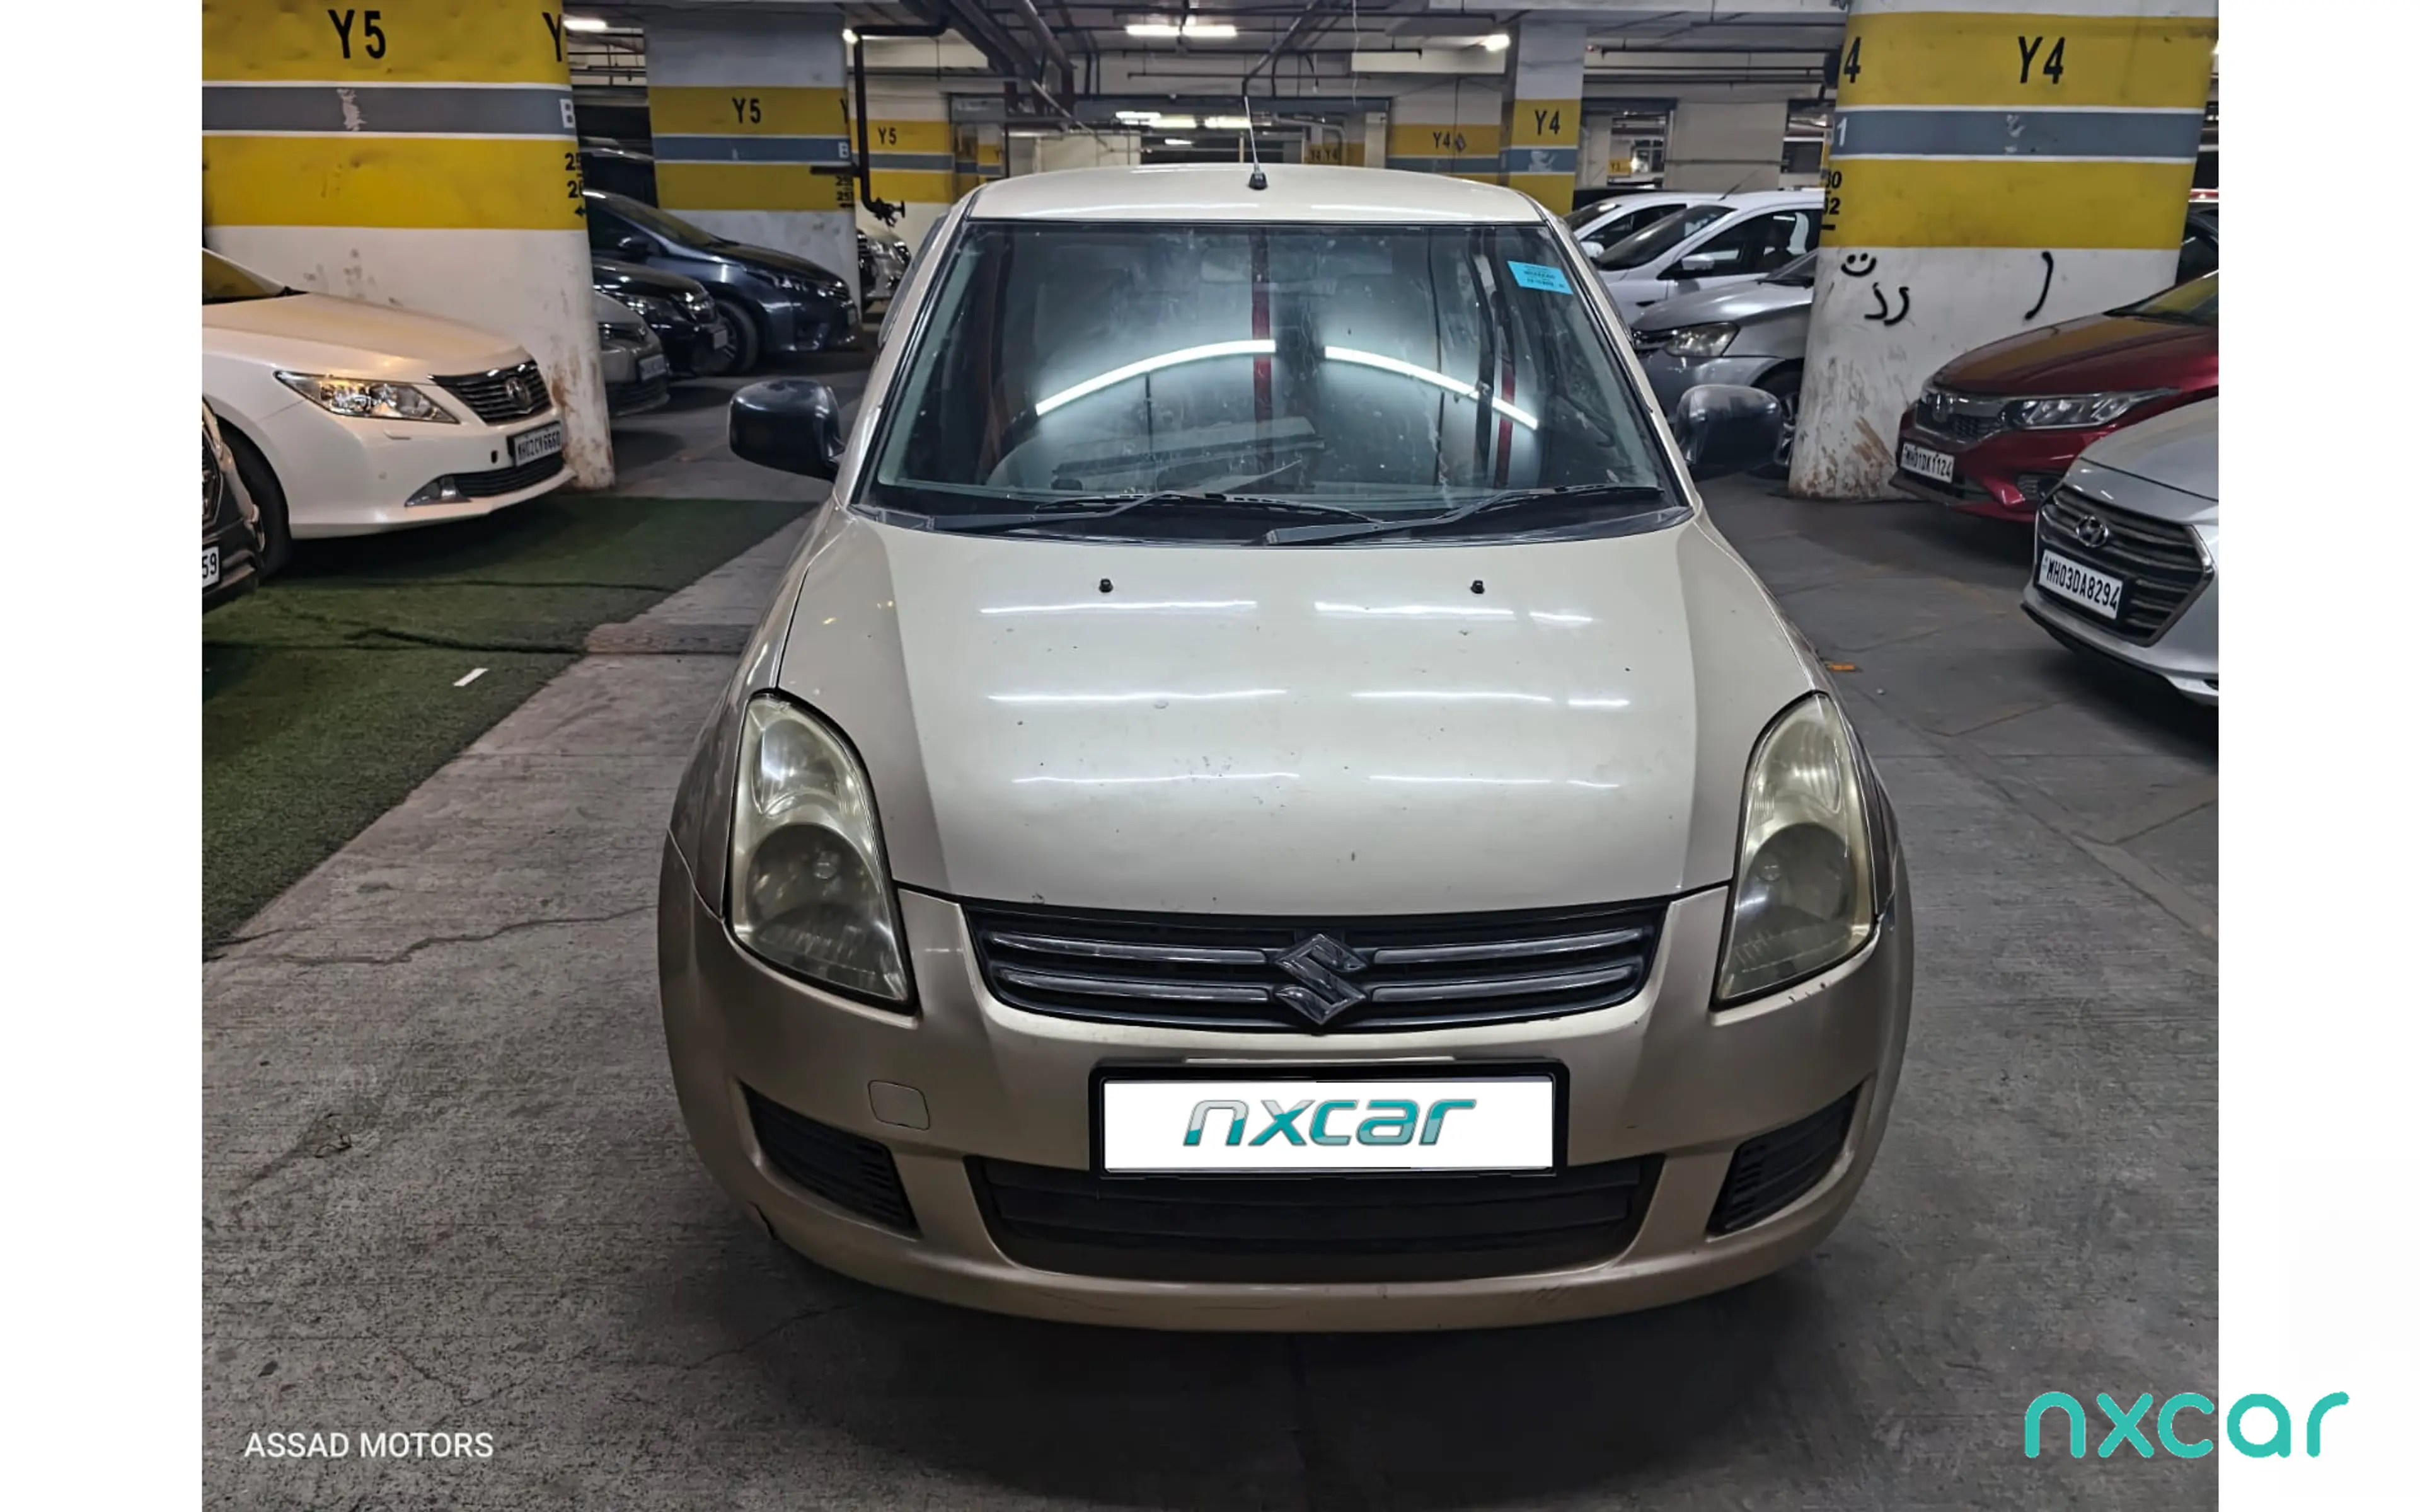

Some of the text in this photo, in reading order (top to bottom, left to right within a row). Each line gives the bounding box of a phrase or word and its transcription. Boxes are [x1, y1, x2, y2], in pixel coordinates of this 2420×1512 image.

[328, 9, 386, 59] Y5
[2018, 36, 2065, 84] Y4
[732, 96, 761, 124] Y5
[1534, 108, 1560, 136] Y4
[878, 127, 896, 145] Y5
[1432, 131, 1451, 149] Y4
[2046, 558, 2120, 611] MH03DA8294
